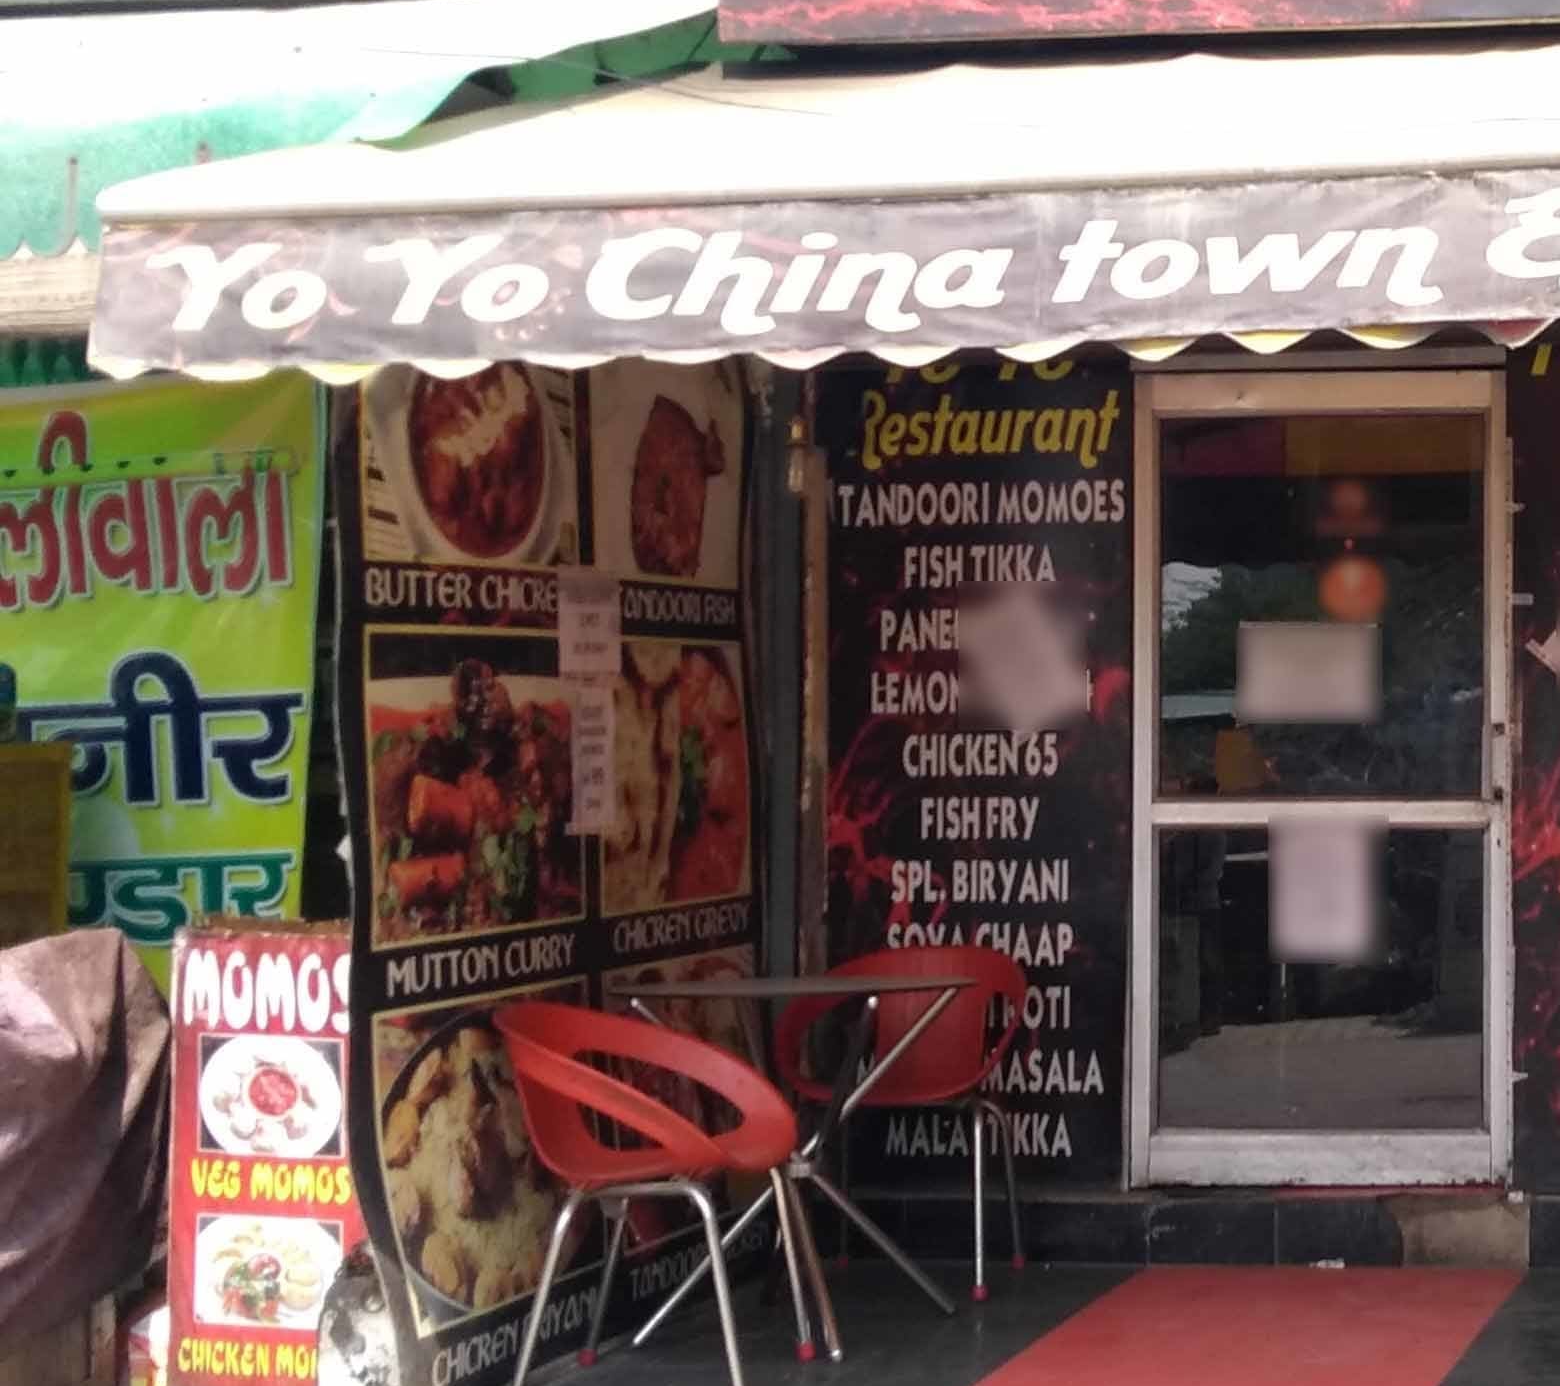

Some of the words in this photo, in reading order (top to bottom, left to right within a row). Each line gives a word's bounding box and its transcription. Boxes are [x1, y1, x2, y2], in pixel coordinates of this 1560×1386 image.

[147, 242, 328, 332] Yo
[364, 234, 550, 325] Yo
[585, 227, 1014, 335] China
[1051, 220, 1443, 307] town
[862, 389, 1120, 470] Restaurant
[839, 481, 990, 528] TANDOORI
[999, 479, 1125, 525] MOMOES
[904, 545, 964, 589] FISH
[970, 544, 1057, 582] TIKKA
[365, 568, 472, 609] BUTTER
[480, 571, 559, 614] CHICKE
[17, 652, 303, 804] नीर
[902, 733, 1021, 778] CHICKEN
[1023, 732, 1059, 777] 65
[920, 797, 985, 841] FISH
[987, 797, 1040, 840] FRY
[953, 859, 1070, 904] BIRYANI
[386, 947, 498, 998] MUTTON
[504, 933, 576, 979] CURRY
[975, 922, 1074, 966] CHAAP
[981, 1049, 1104, 1095] MASALA
[191, 1158, 242, 1200] VEG
[250, 1165, 352, 1206] MOMOS
[177, 1338, 269, 1379] CHICKEN
